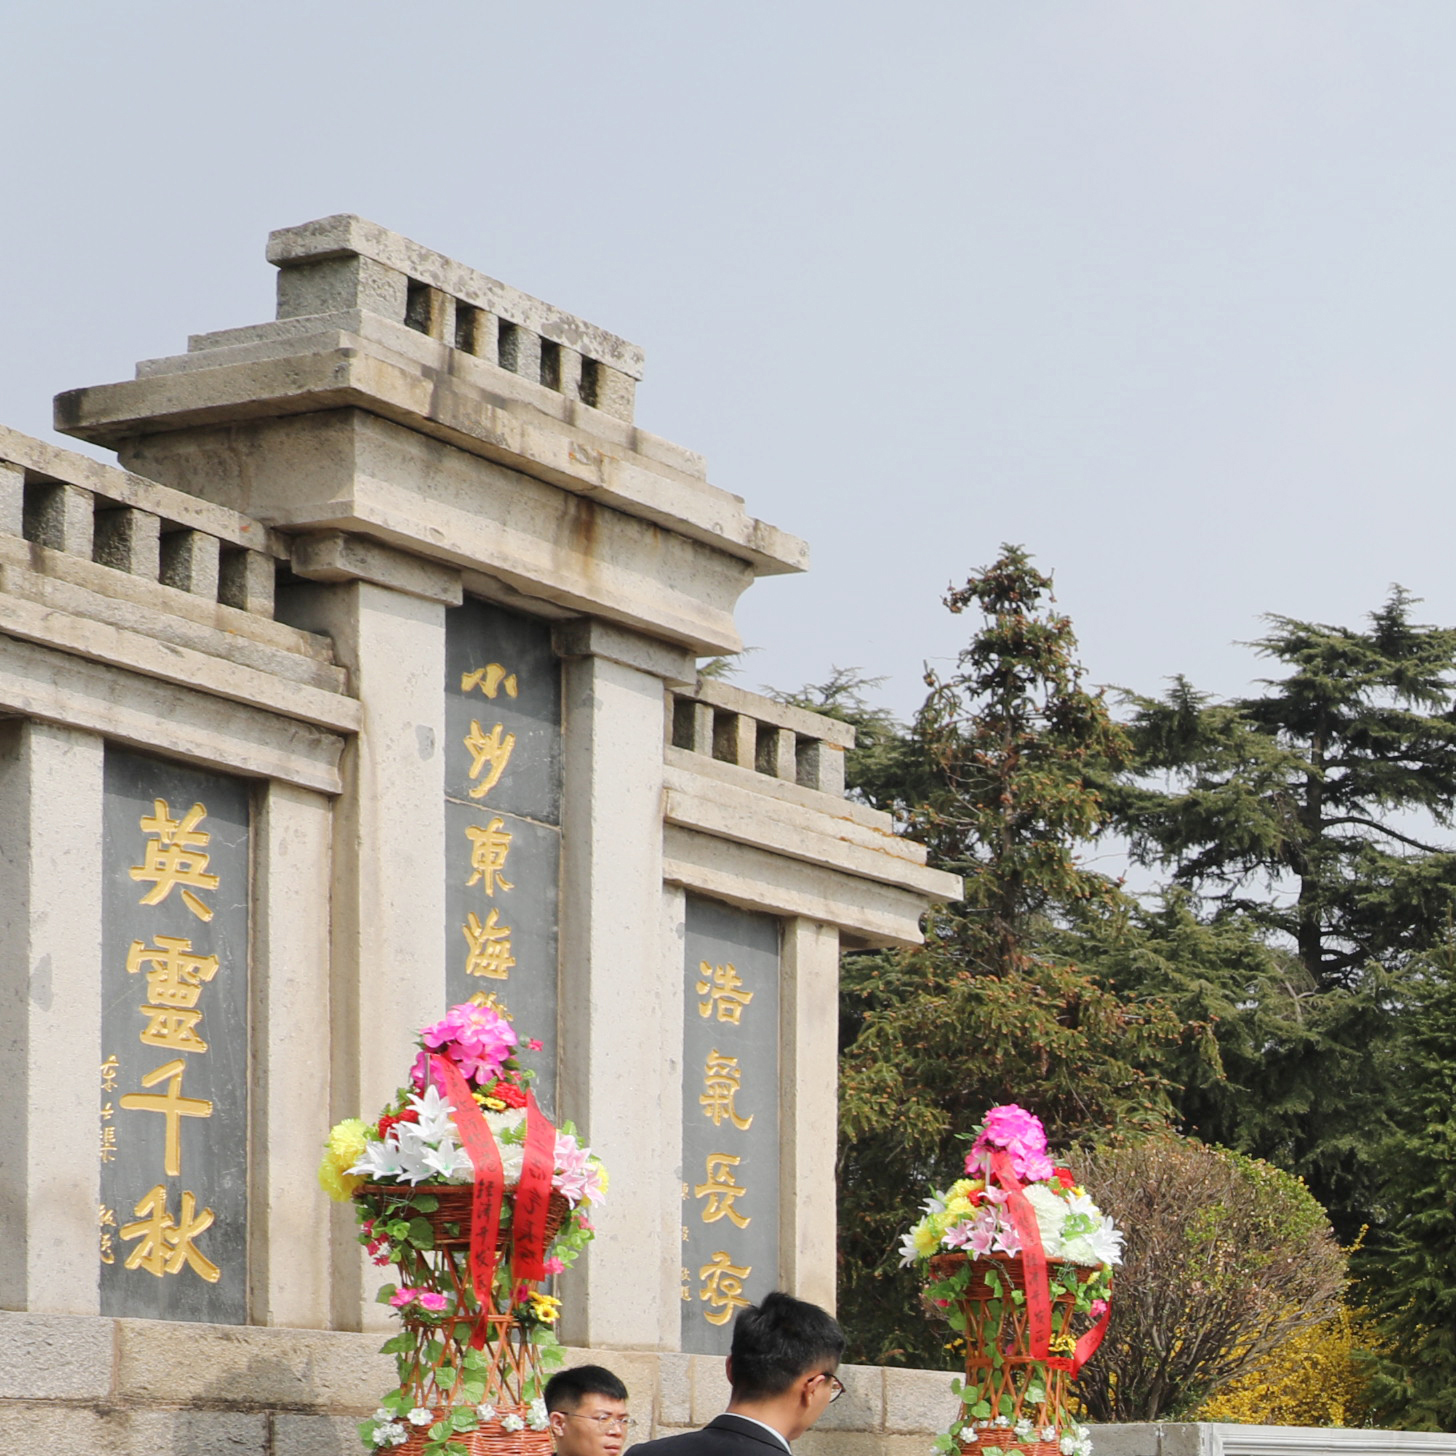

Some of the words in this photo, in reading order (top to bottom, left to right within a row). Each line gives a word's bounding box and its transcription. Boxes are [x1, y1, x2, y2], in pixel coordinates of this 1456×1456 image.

[121, 798, 222, 1284] 英靈千秋
[695, 960, 753, 1326] 浩氣長存
